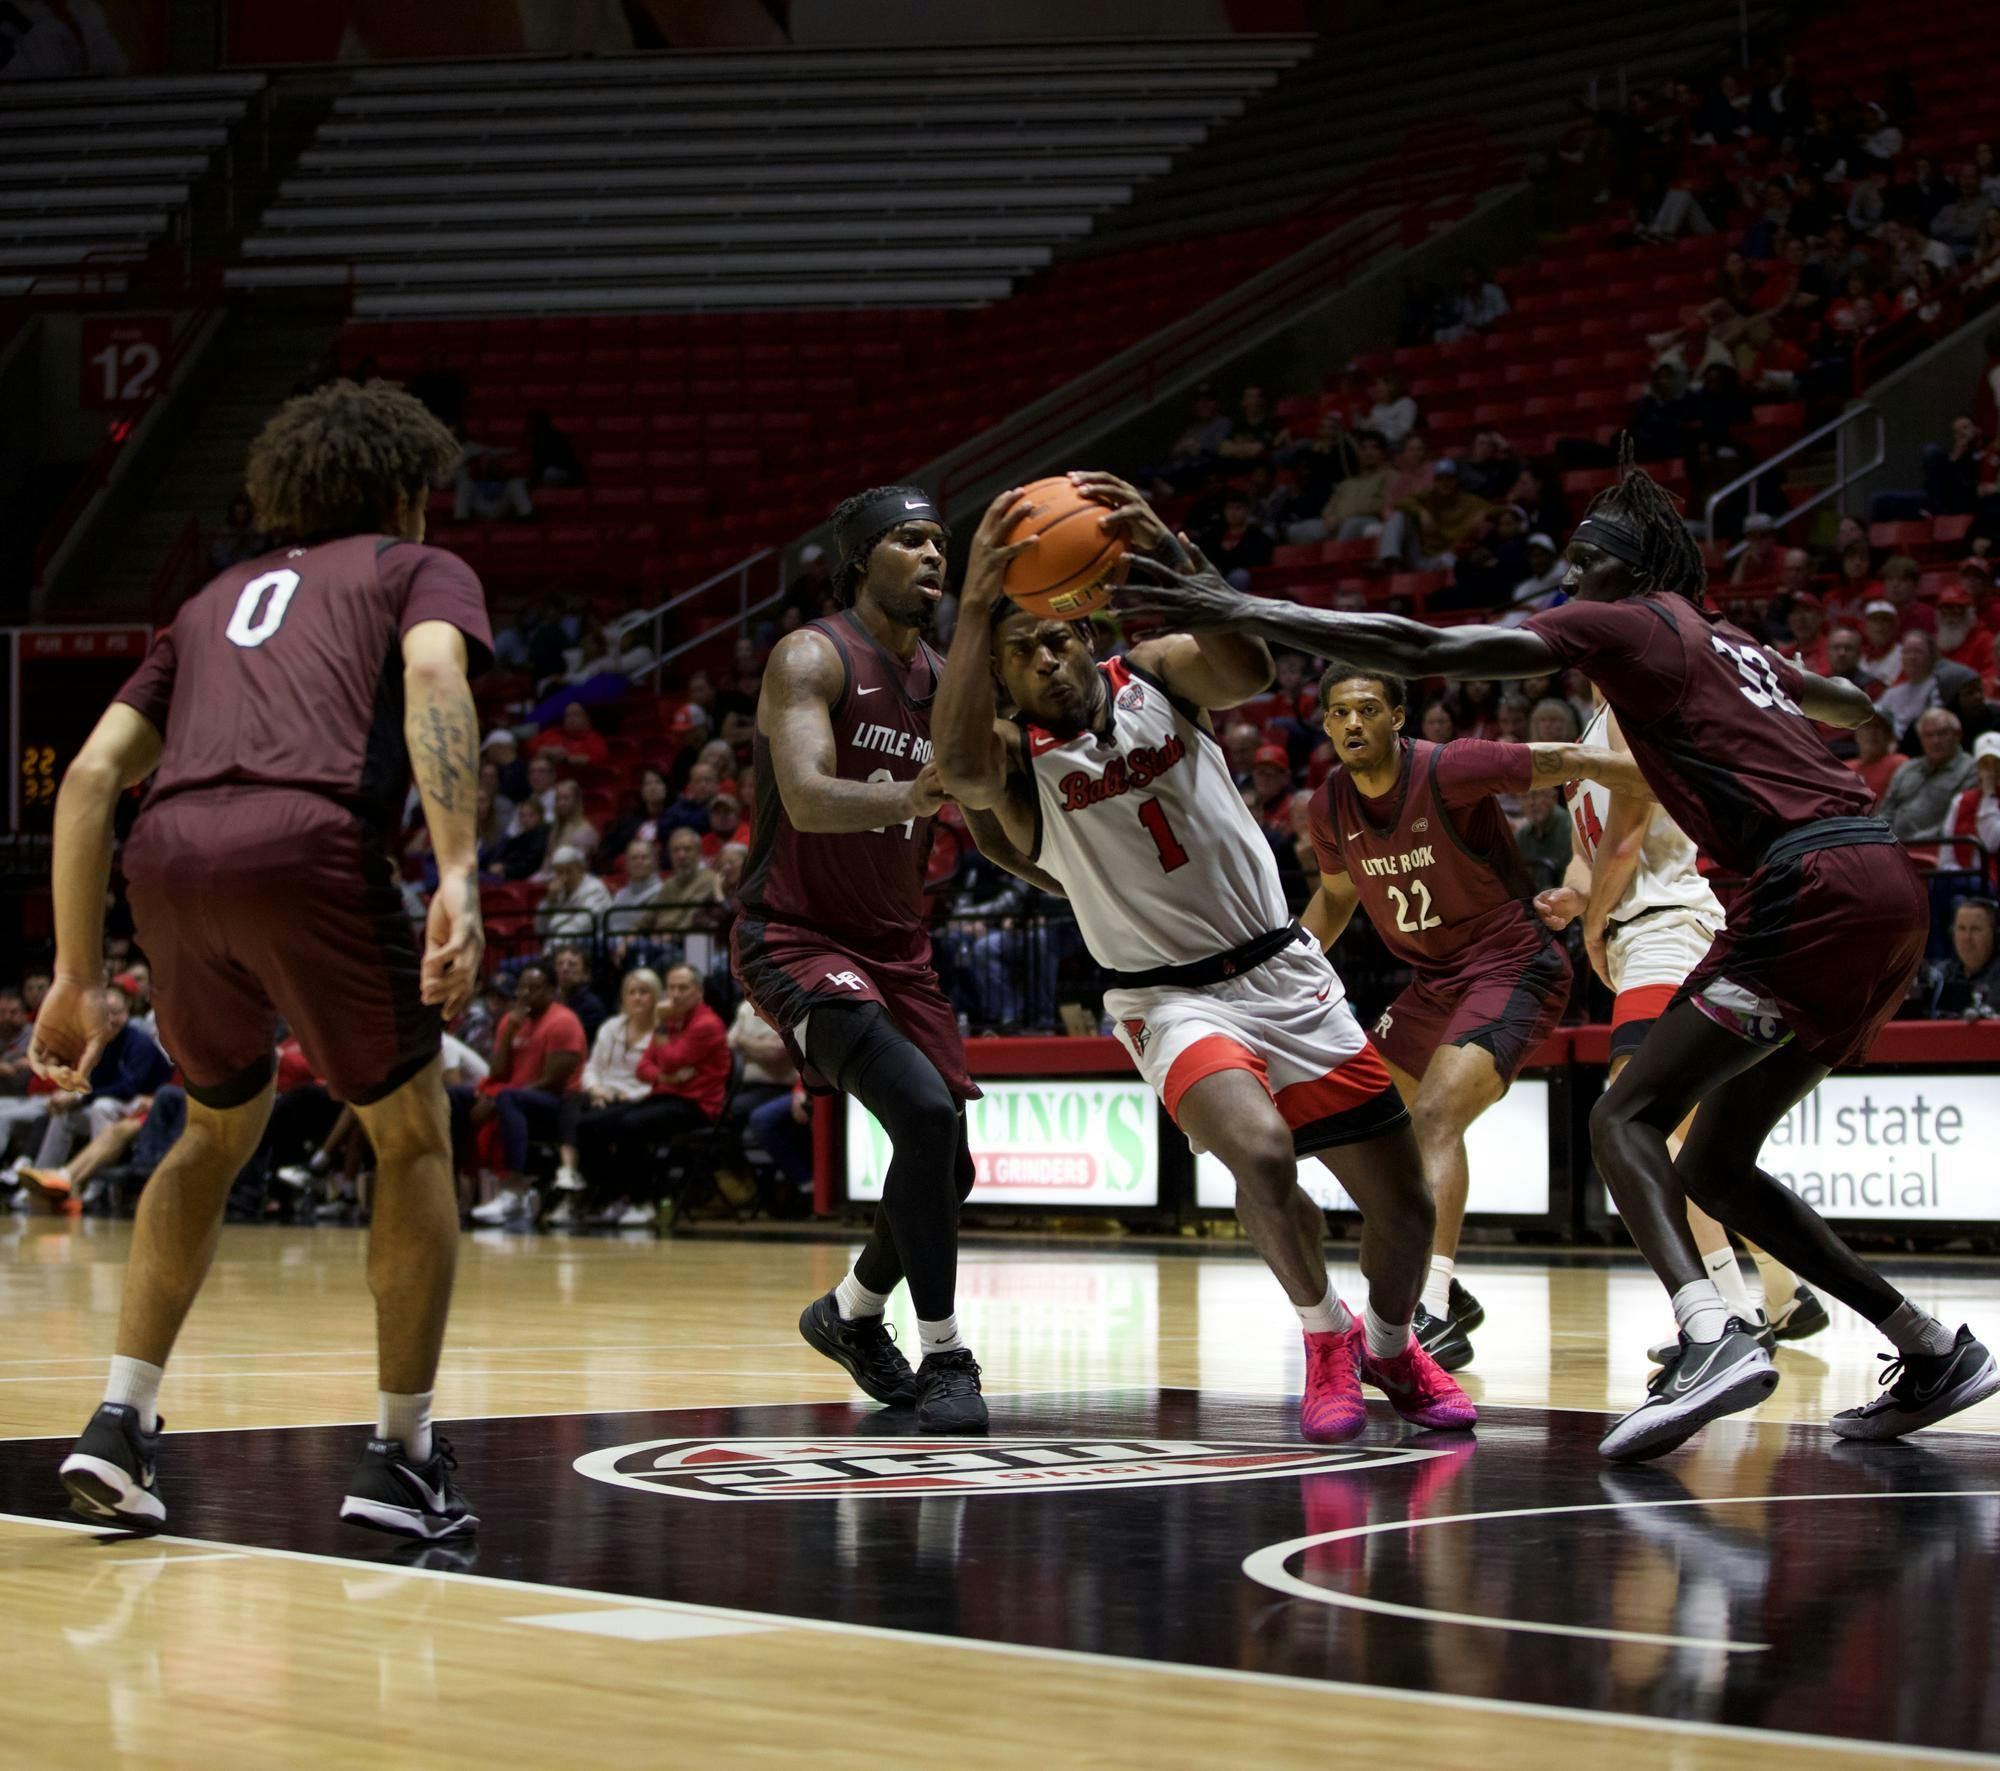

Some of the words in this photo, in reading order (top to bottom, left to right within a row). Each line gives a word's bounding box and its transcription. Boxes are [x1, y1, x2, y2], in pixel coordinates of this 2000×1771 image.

[91, 342, 161, 400] 12
[225, 568, 301, 648] 0
[851, 721, 910, 757] LITTLE
[910, 736, 935, 764] RO
[1059, 756, 1129, 811] Ball
[1138, 796, 1189, 873] 1
[1361, 855, 1399, 876] LITTLE
[1400, 845, 1436, 873] ROCK
[1387, 879, 1443, 933] 22
[1768, 1084, 1821, 1146] all
[1836, 1095, 1964, 1146] state
[995, 1158, 1089, 1185] GRINDERS
[994, 1465, 1162, 1481] 1946
